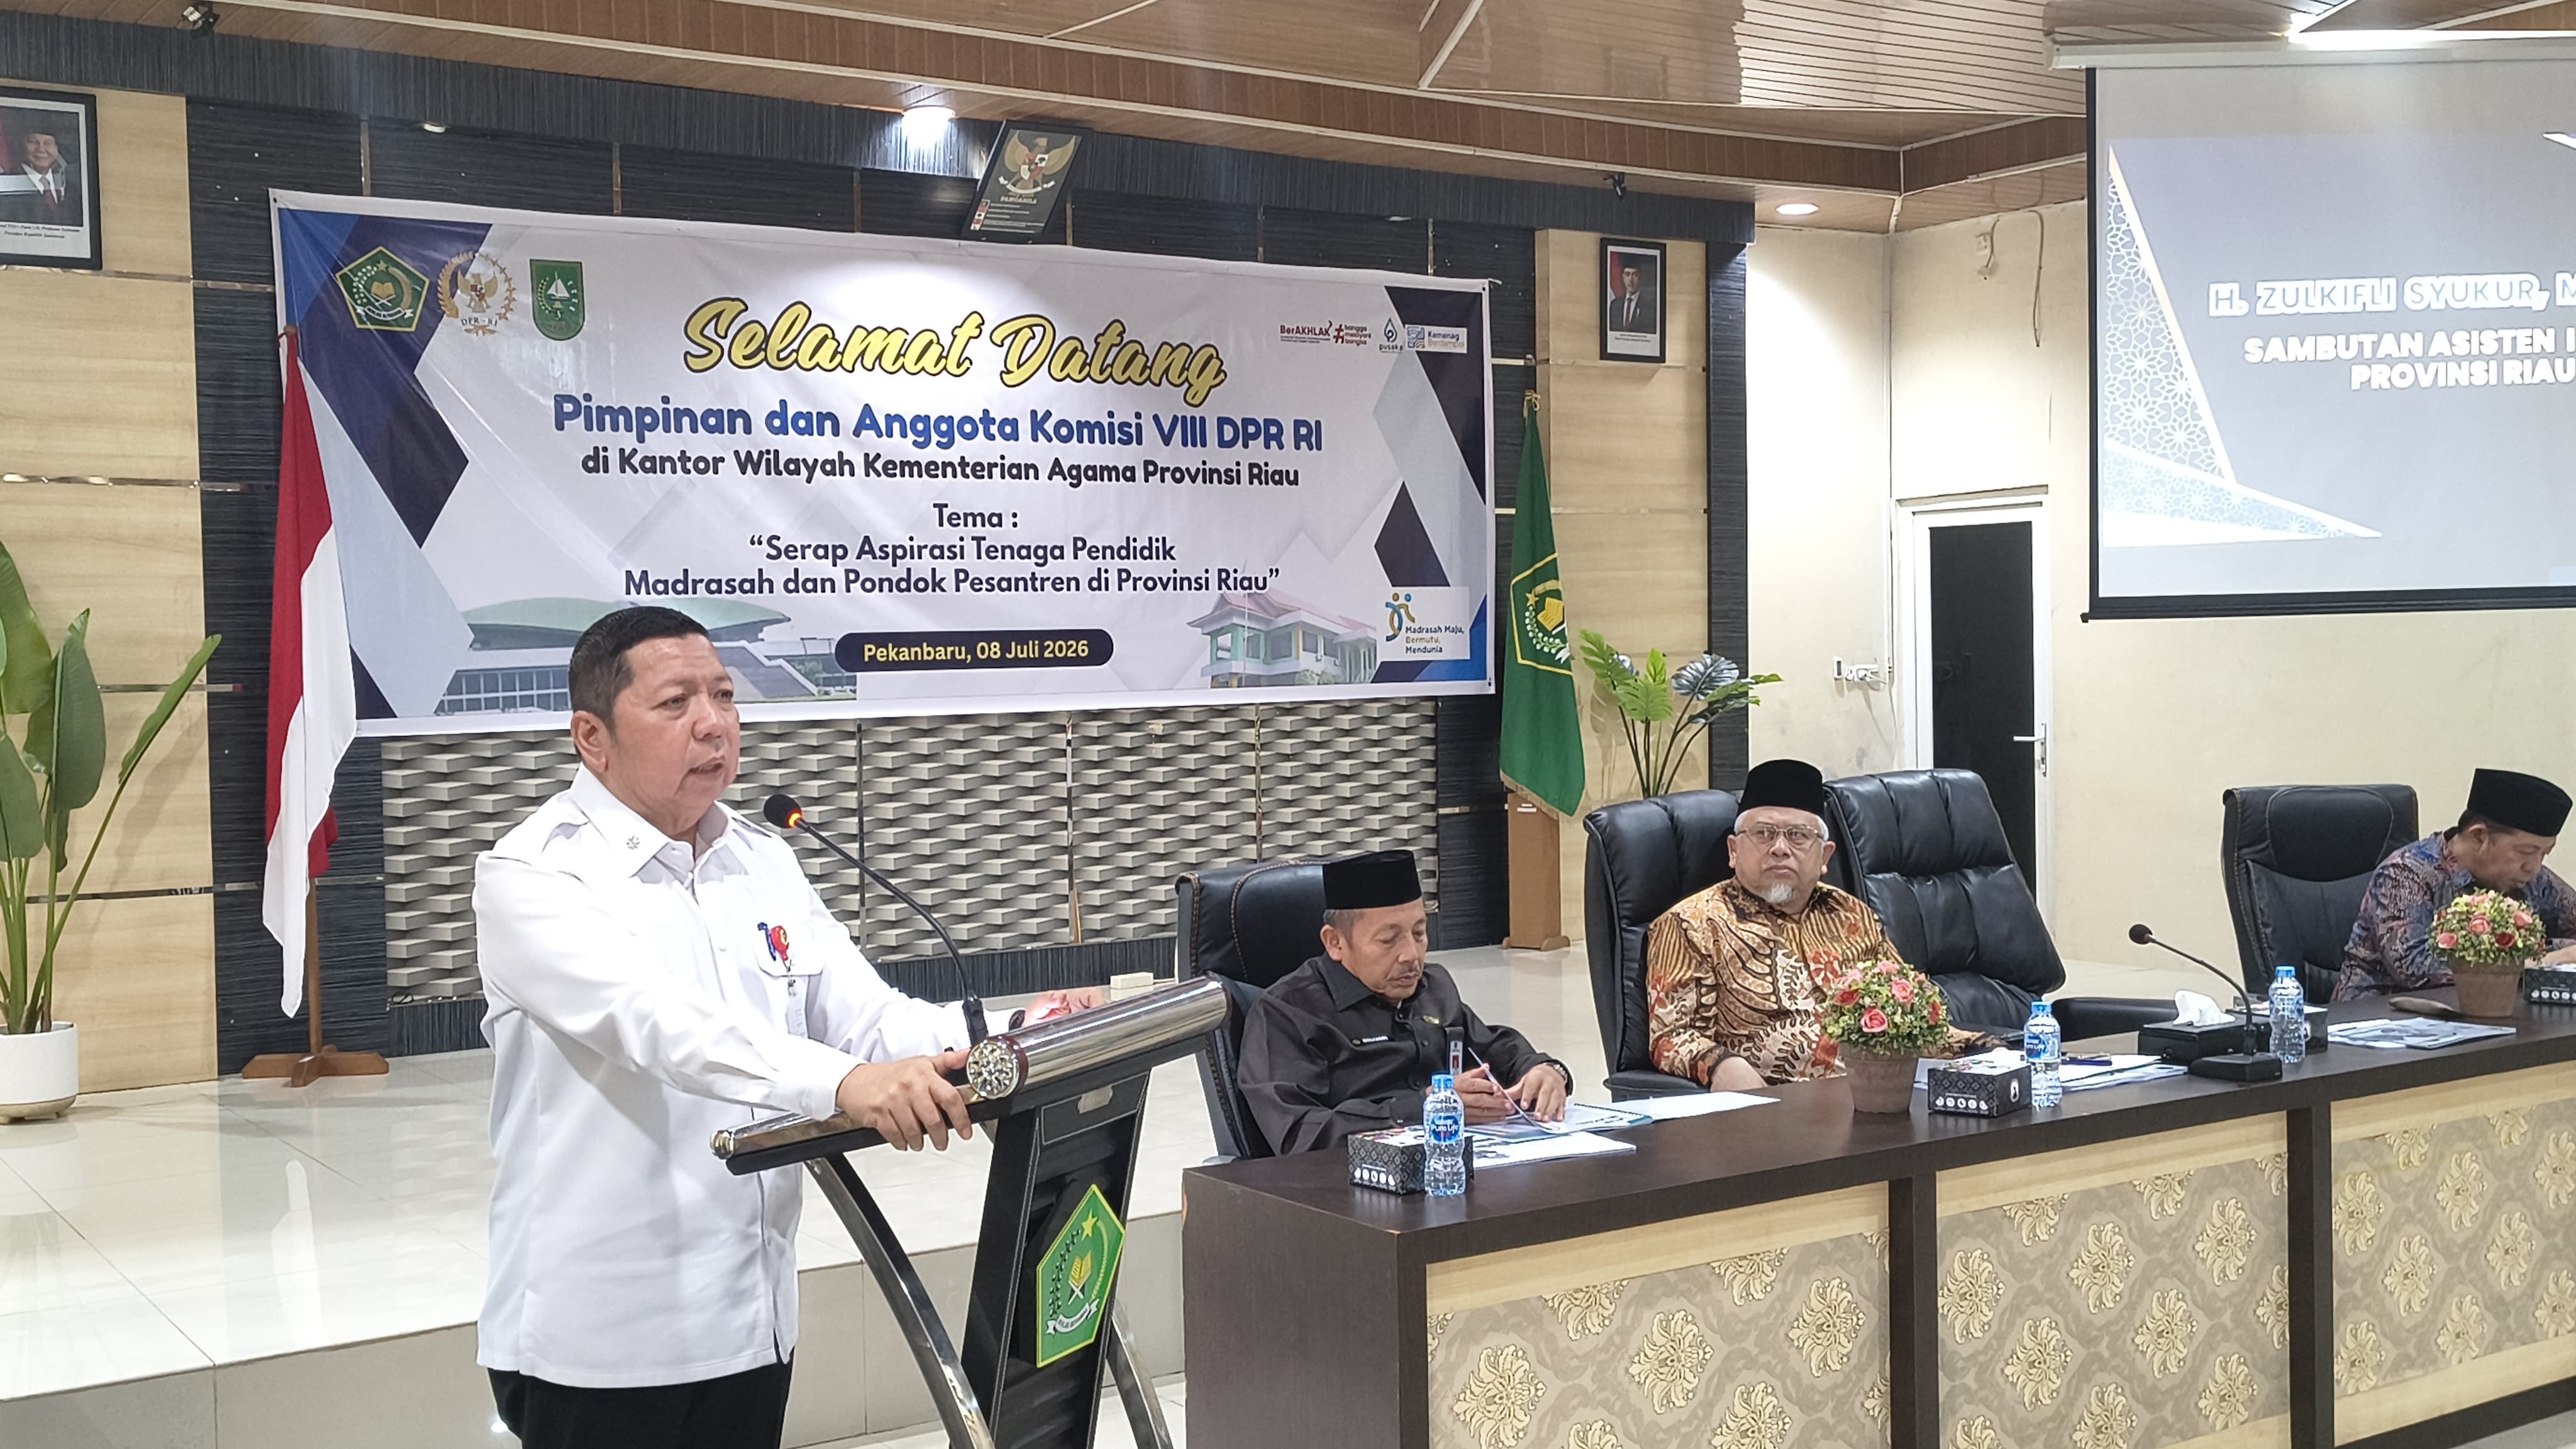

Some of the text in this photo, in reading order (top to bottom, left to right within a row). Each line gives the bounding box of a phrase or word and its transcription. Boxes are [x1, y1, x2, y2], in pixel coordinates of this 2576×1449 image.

[2209, 282, 2249, 316] H.
[2257, 278, 2397, 315] ZULKIFLI
[2404, 272, 2550, 311] SYUKUR,
[684, 297, 1227, 408] Selamat Datang
[2243, 331, 2424, 364] SAMBUTAN
[2427, 328, 2555, 357] ASISTEN
[2350, 357, 2576, 391] PROVINSI RIAU
[553, 392, 1323, 451] Pimpinan dan Anggota Komisi VIII DPR RI
[582, 446, 1299, 488] di Kantor Wilayah Kementerian Agama Provinsi Riau
[933, 502, 1002, 528] Tema
[855, 535, 966, 567] Aspirasi
[970, 536, 1065, 566] Tenaga
[1072, 536, 1177, 561] Pendidik
[625, 569, 775, 596] Madrasah
[782, 568, 836, 594] dan
[844, 567, 947, 594] Pondok
[953, 569, 1080, 593] Pesantren
[1086, 568, 1110, 593] di
[1116, 568, 1210, 592] Provinsi
[1405, 626, 1465, 635] Madrasah Maju,
[863, 640, 1089, 664] Pekanbaru, 08 Juli 2026
[1405, 645, 1443, 654] Mendunia
